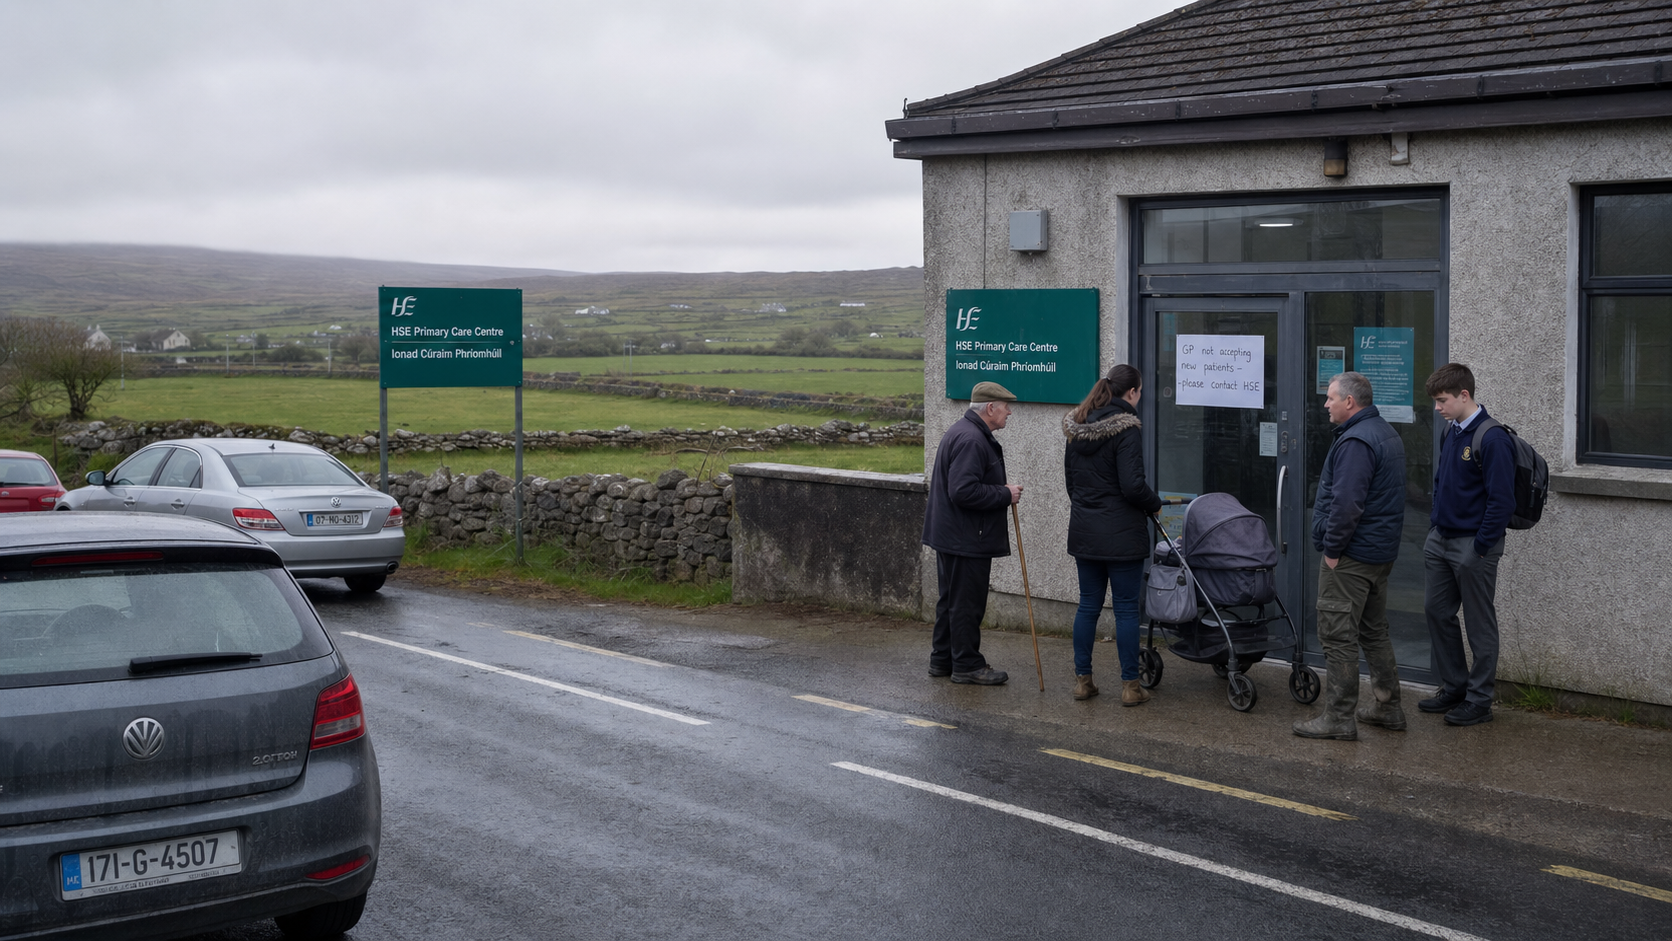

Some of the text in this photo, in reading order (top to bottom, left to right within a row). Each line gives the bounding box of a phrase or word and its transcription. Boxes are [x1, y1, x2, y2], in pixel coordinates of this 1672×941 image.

[391, 326, 504, 338] HSE Primary Care Centre
[391, 349, 418, 358] Ionad
[420, 348, 453, 358] Cúraim
[955, 341, 1058, 353] HSE Primary Care Centre
[1182, 344, 1251, 363] GP not accepting
[955, 360, 978, 370] Ionad
[980, 360, 1008, 371] Cúraim
[1181, 362, 1196, 370] new
[1204, 362, 1234, 376] patients
[1211, 380, 1238, 390] contact
[1243, 381, 1260, 391] HSE
[87, 838, 219, 883] 171-G-4507
